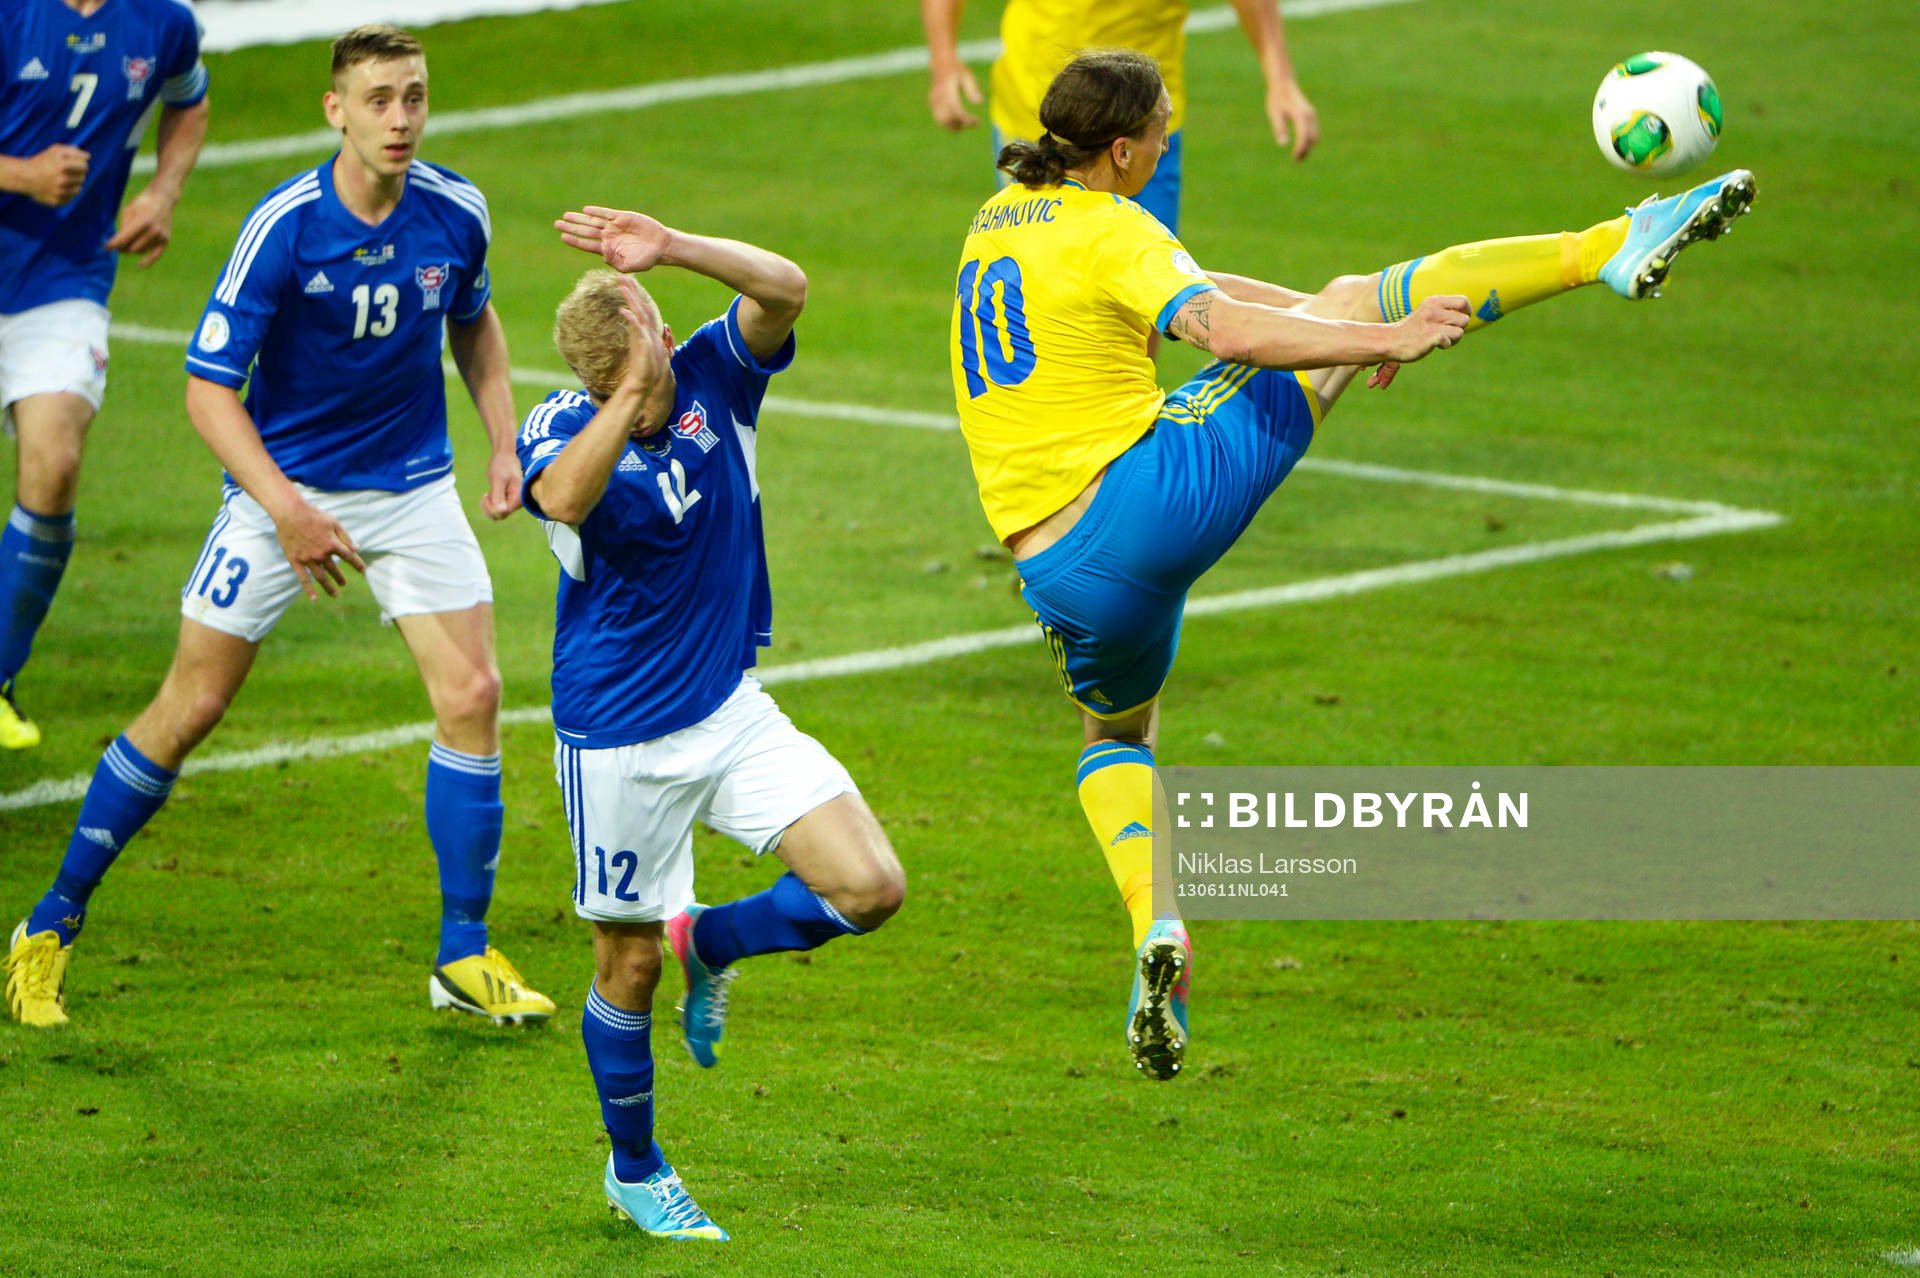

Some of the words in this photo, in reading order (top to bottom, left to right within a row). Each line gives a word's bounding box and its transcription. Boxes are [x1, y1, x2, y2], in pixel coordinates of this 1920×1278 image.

[66, 72, 98, 129] 7
[968, 197, 1063, 235] RAHIMOVIĆ
[352, 283, 399, 340] 13
[957, 255, 1037, 400] 10
[618, 463, 648, 472] adidas
[656, 458, 702, 524] 12
[198, 546, 250, 609] 13
[595, 846, 640, 902] 12
